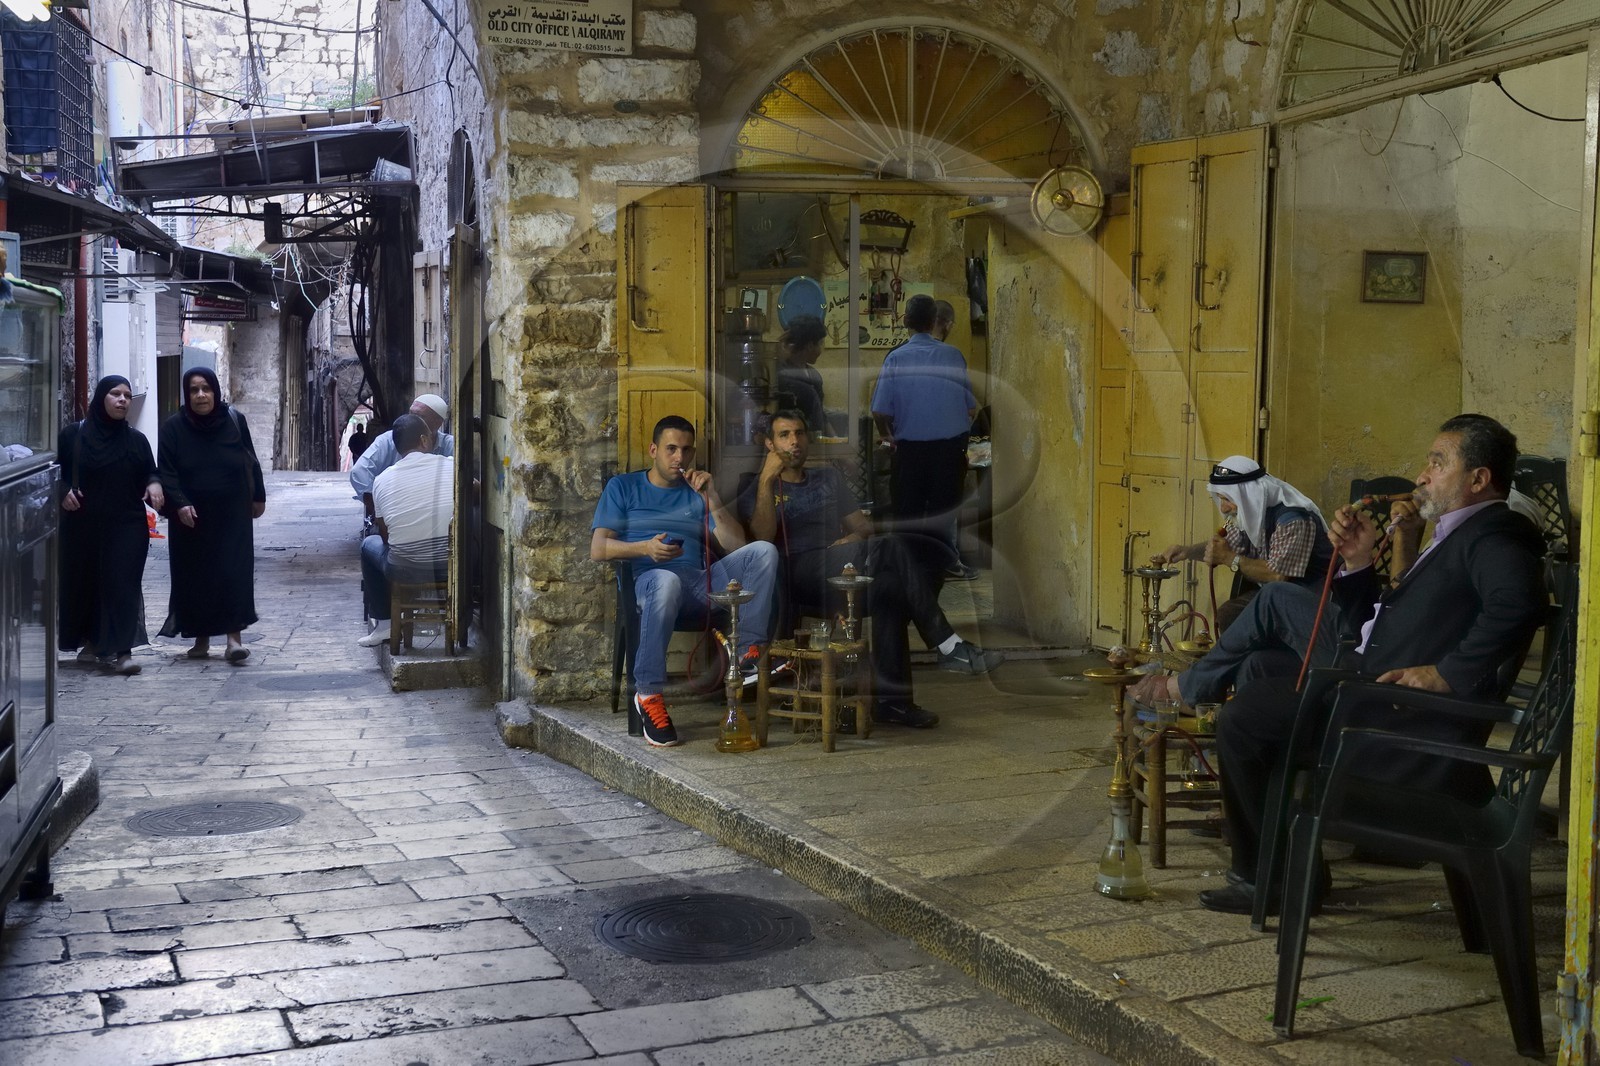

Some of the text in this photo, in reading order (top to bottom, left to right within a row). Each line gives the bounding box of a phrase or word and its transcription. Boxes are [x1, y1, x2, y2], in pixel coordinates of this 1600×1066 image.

[488, 5, 521, 20] القرمي
[531, 6, 569, 23] القديمة
[572, 10, 600, 26] البلدة
[602, 13, 626, 28] مكتب
[488, 19, 509, 32] OLD
[511, 21, 533, 33] CITY
[535, 23, 570, 37] OFFICE
[577, 27, 626, 41] ALQIRAMY
